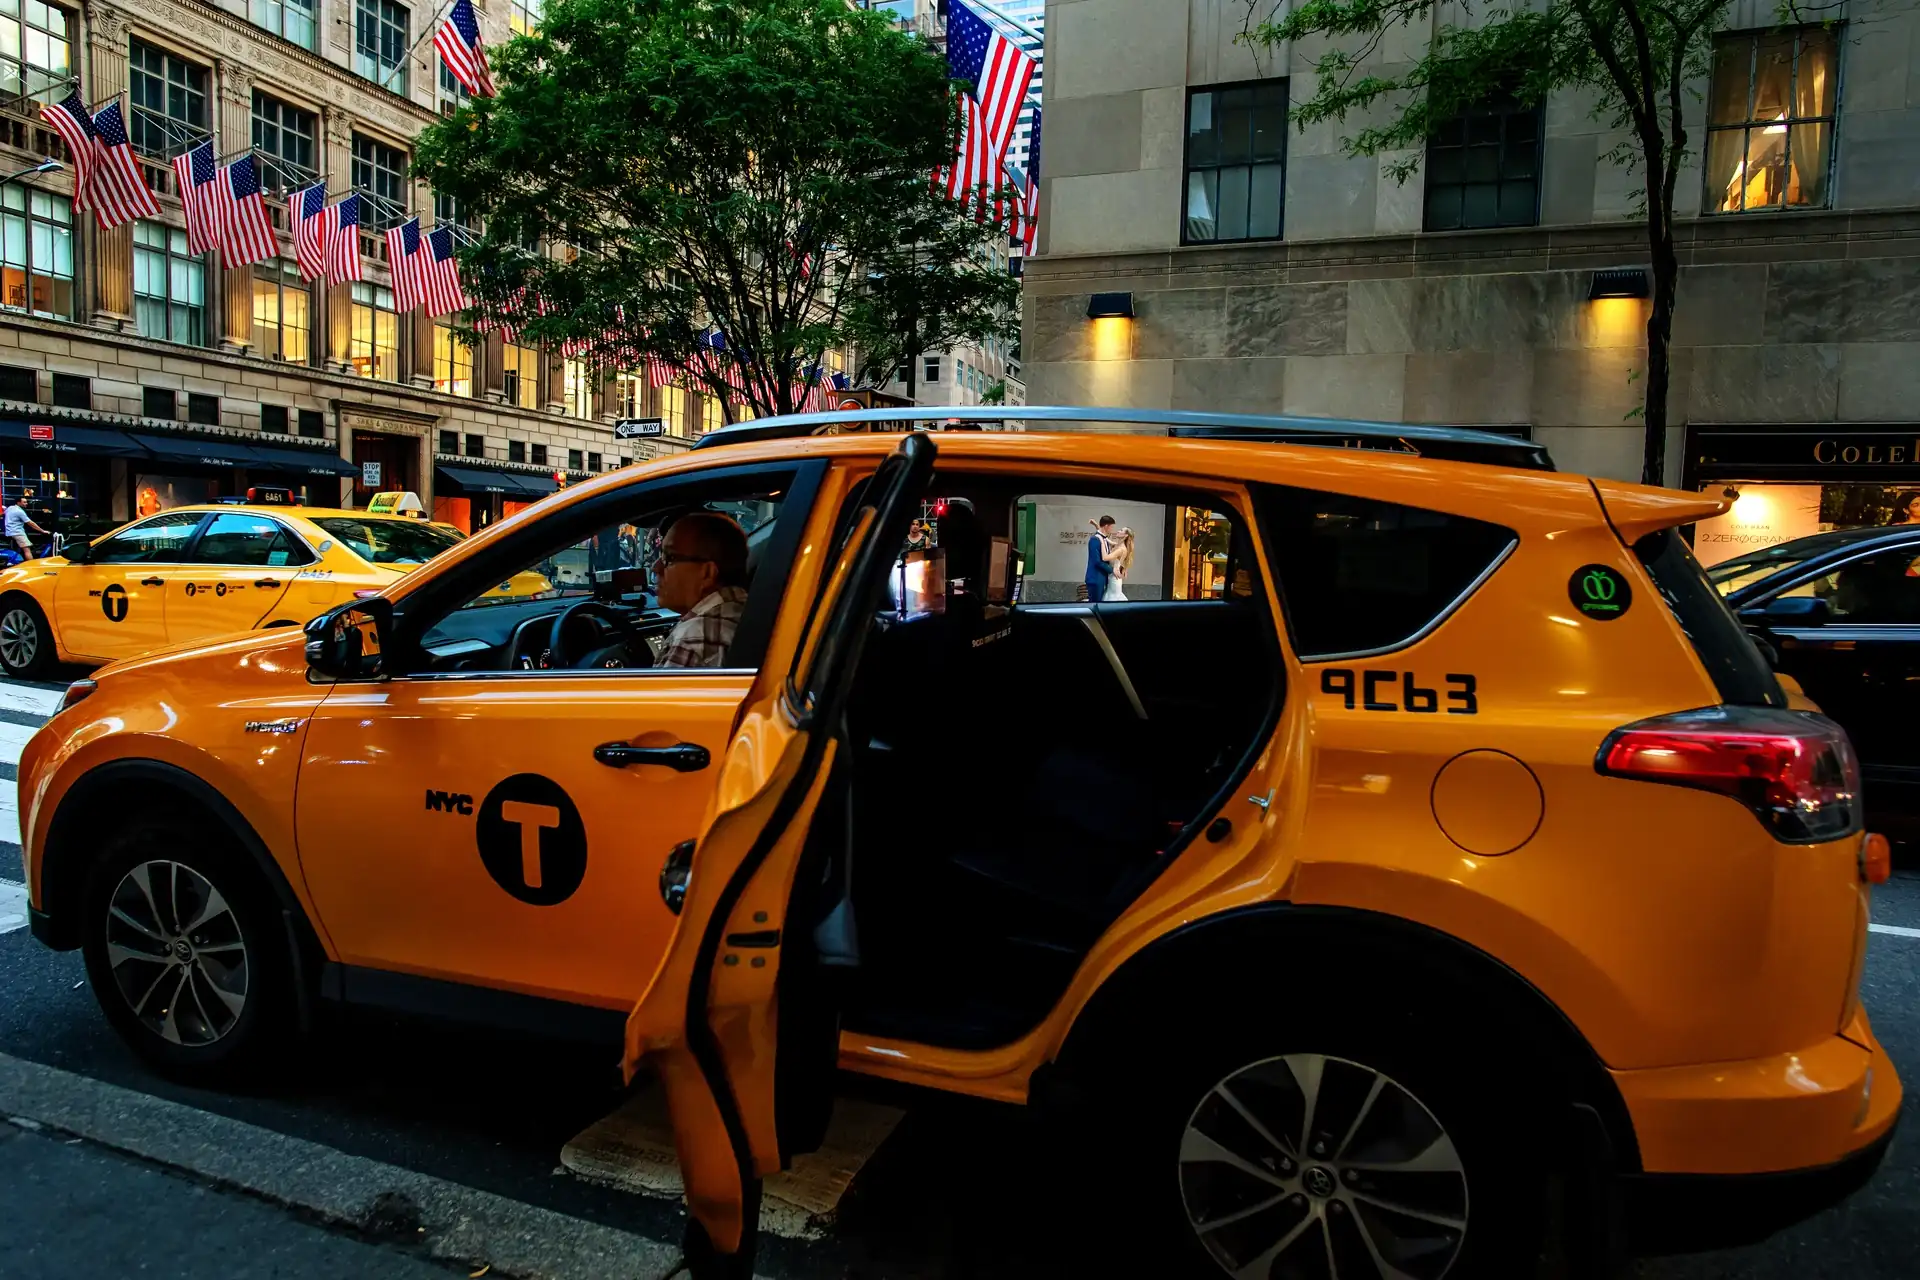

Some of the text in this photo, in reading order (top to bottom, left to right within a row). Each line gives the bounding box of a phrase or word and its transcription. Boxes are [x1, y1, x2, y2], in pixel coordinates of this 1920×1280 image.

[382, 421, 418, 432] COMPAN
[620, 423, 658, 434] ONE WAY
[1813, 440, 1905, 464] COLE
[265, 492, 282, 502] 6A61
[425, 789, 560, 889] NYC T
